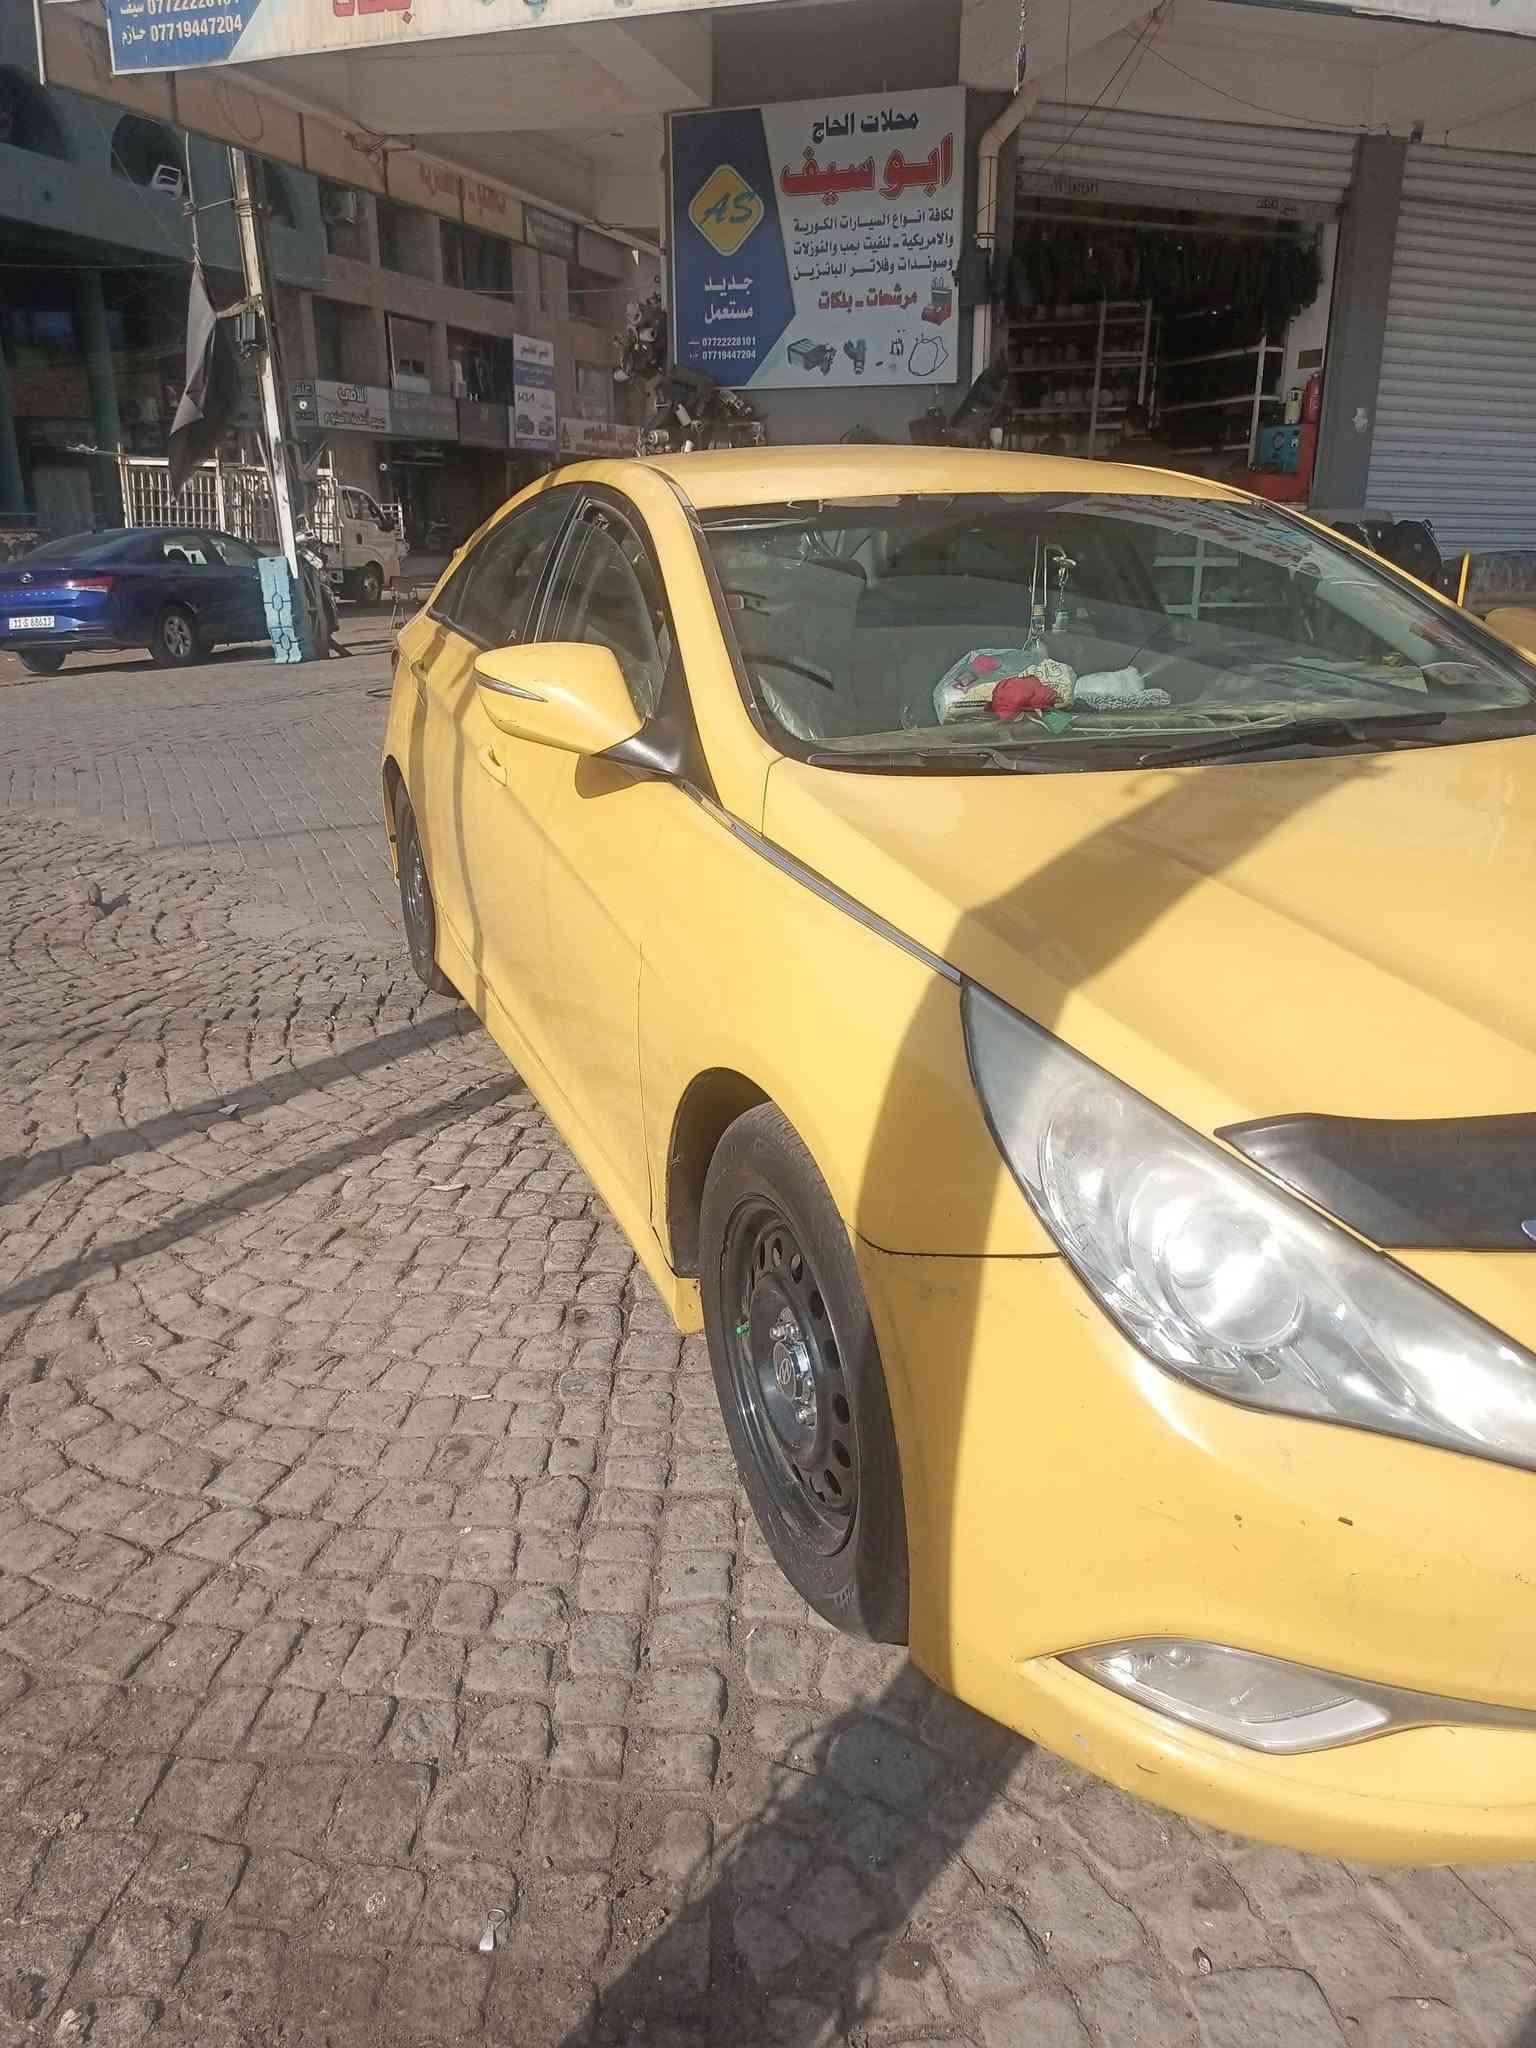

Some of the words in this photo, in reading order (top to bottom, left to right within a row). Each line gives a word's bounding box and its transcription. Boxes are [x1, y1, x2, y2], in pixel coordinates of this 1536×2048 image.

[121, 25, 146, 45] حازم
[150, 14, 243, 42] 07719447204
[812, 111, 855, 144] الحاج
[860, 107, 919, 133] محلات
[780, 145, 876, 207] سيف
[879, 131, 954, 201] ابو
[701, 191, 766, 224] AS
[929, 207, 954, 222] لكافة
[793, 217, 837, 236] الكورية
[840, 214, 890, 232] السيارات
[892, 211, 926, 229] انواع
[902, 231, 954, 250] والامريكية
[704, 274, 753, 297] جديد
[704, 300, 753, 324] مستعمل
[702, 349, 756, 360] 07719447204
